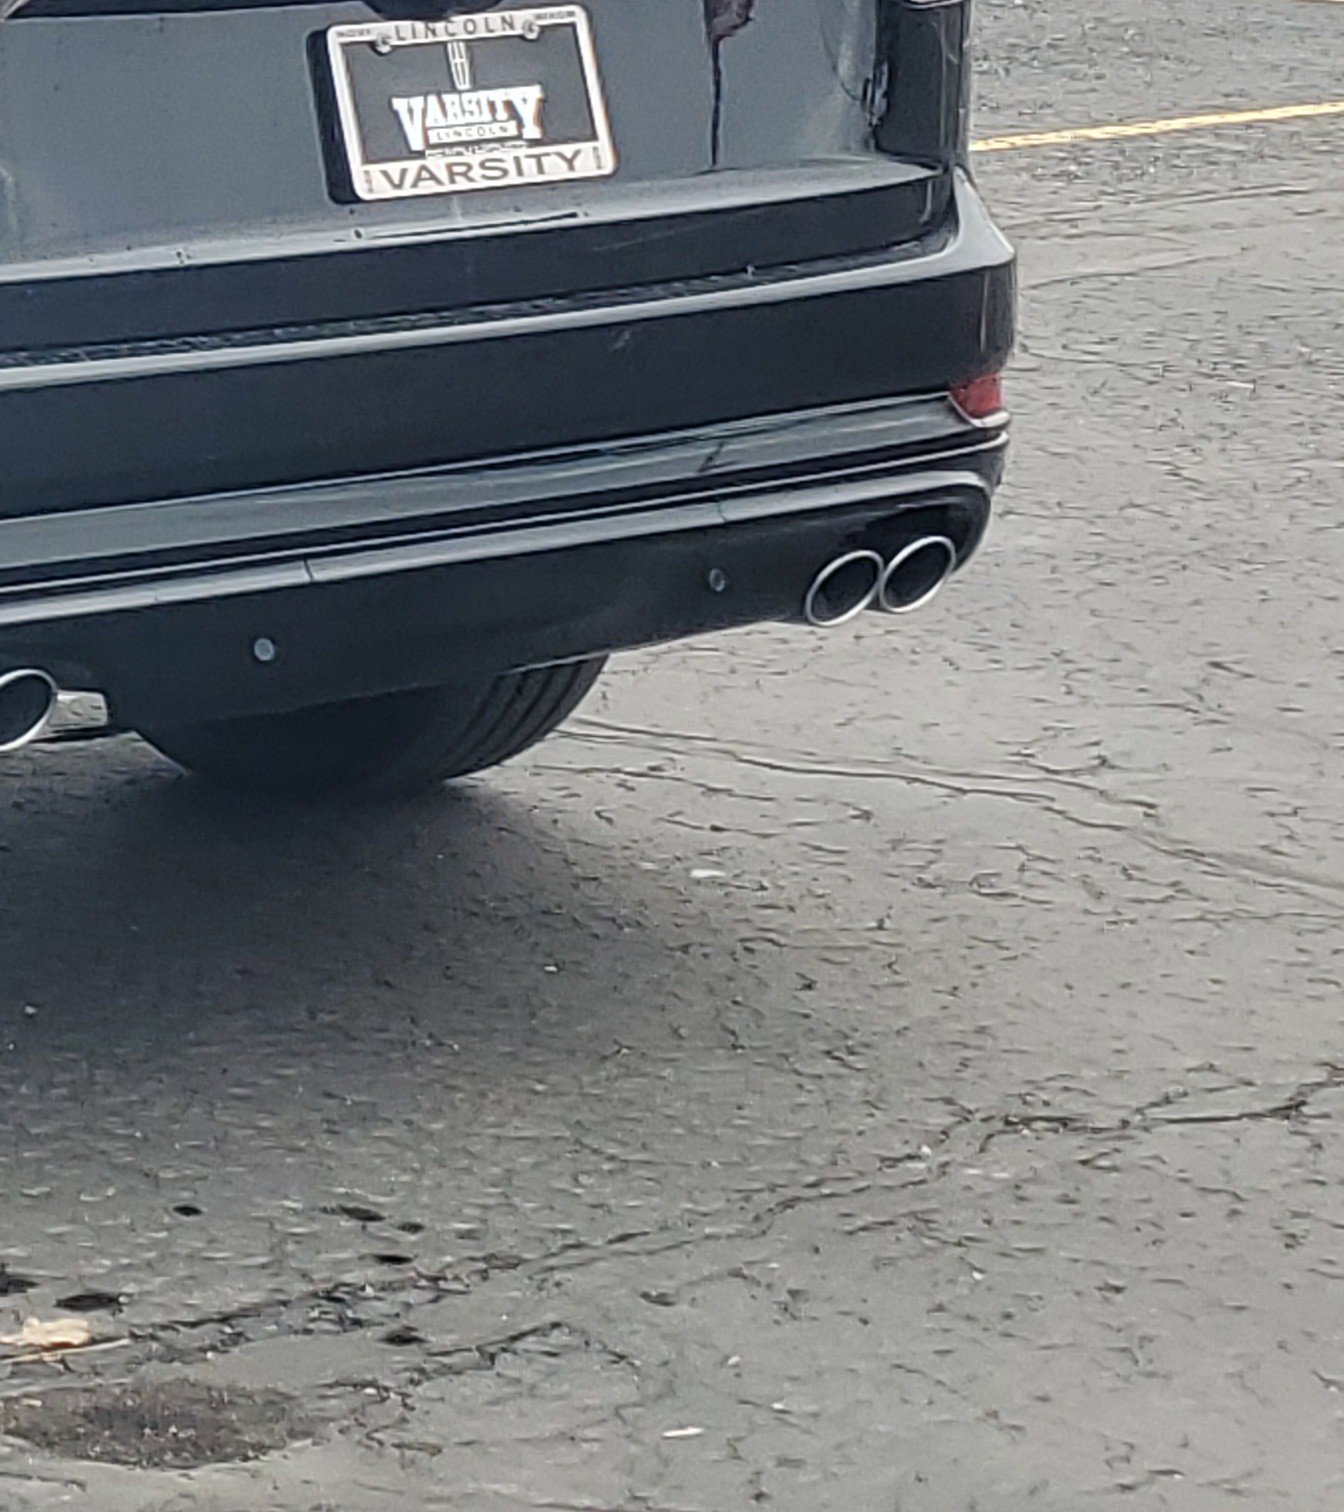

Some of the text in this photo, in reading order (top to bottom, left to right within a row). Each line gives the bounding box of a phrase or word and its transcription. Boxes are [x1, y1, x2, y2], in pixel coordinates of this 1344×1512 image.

[395, 15, 515, 40] LINCOLN
[391, 85, 546, 152] VARSITY
[436, 125, 510, 142] LINCOLN
[380, 149, 583, 192] VARSITY
